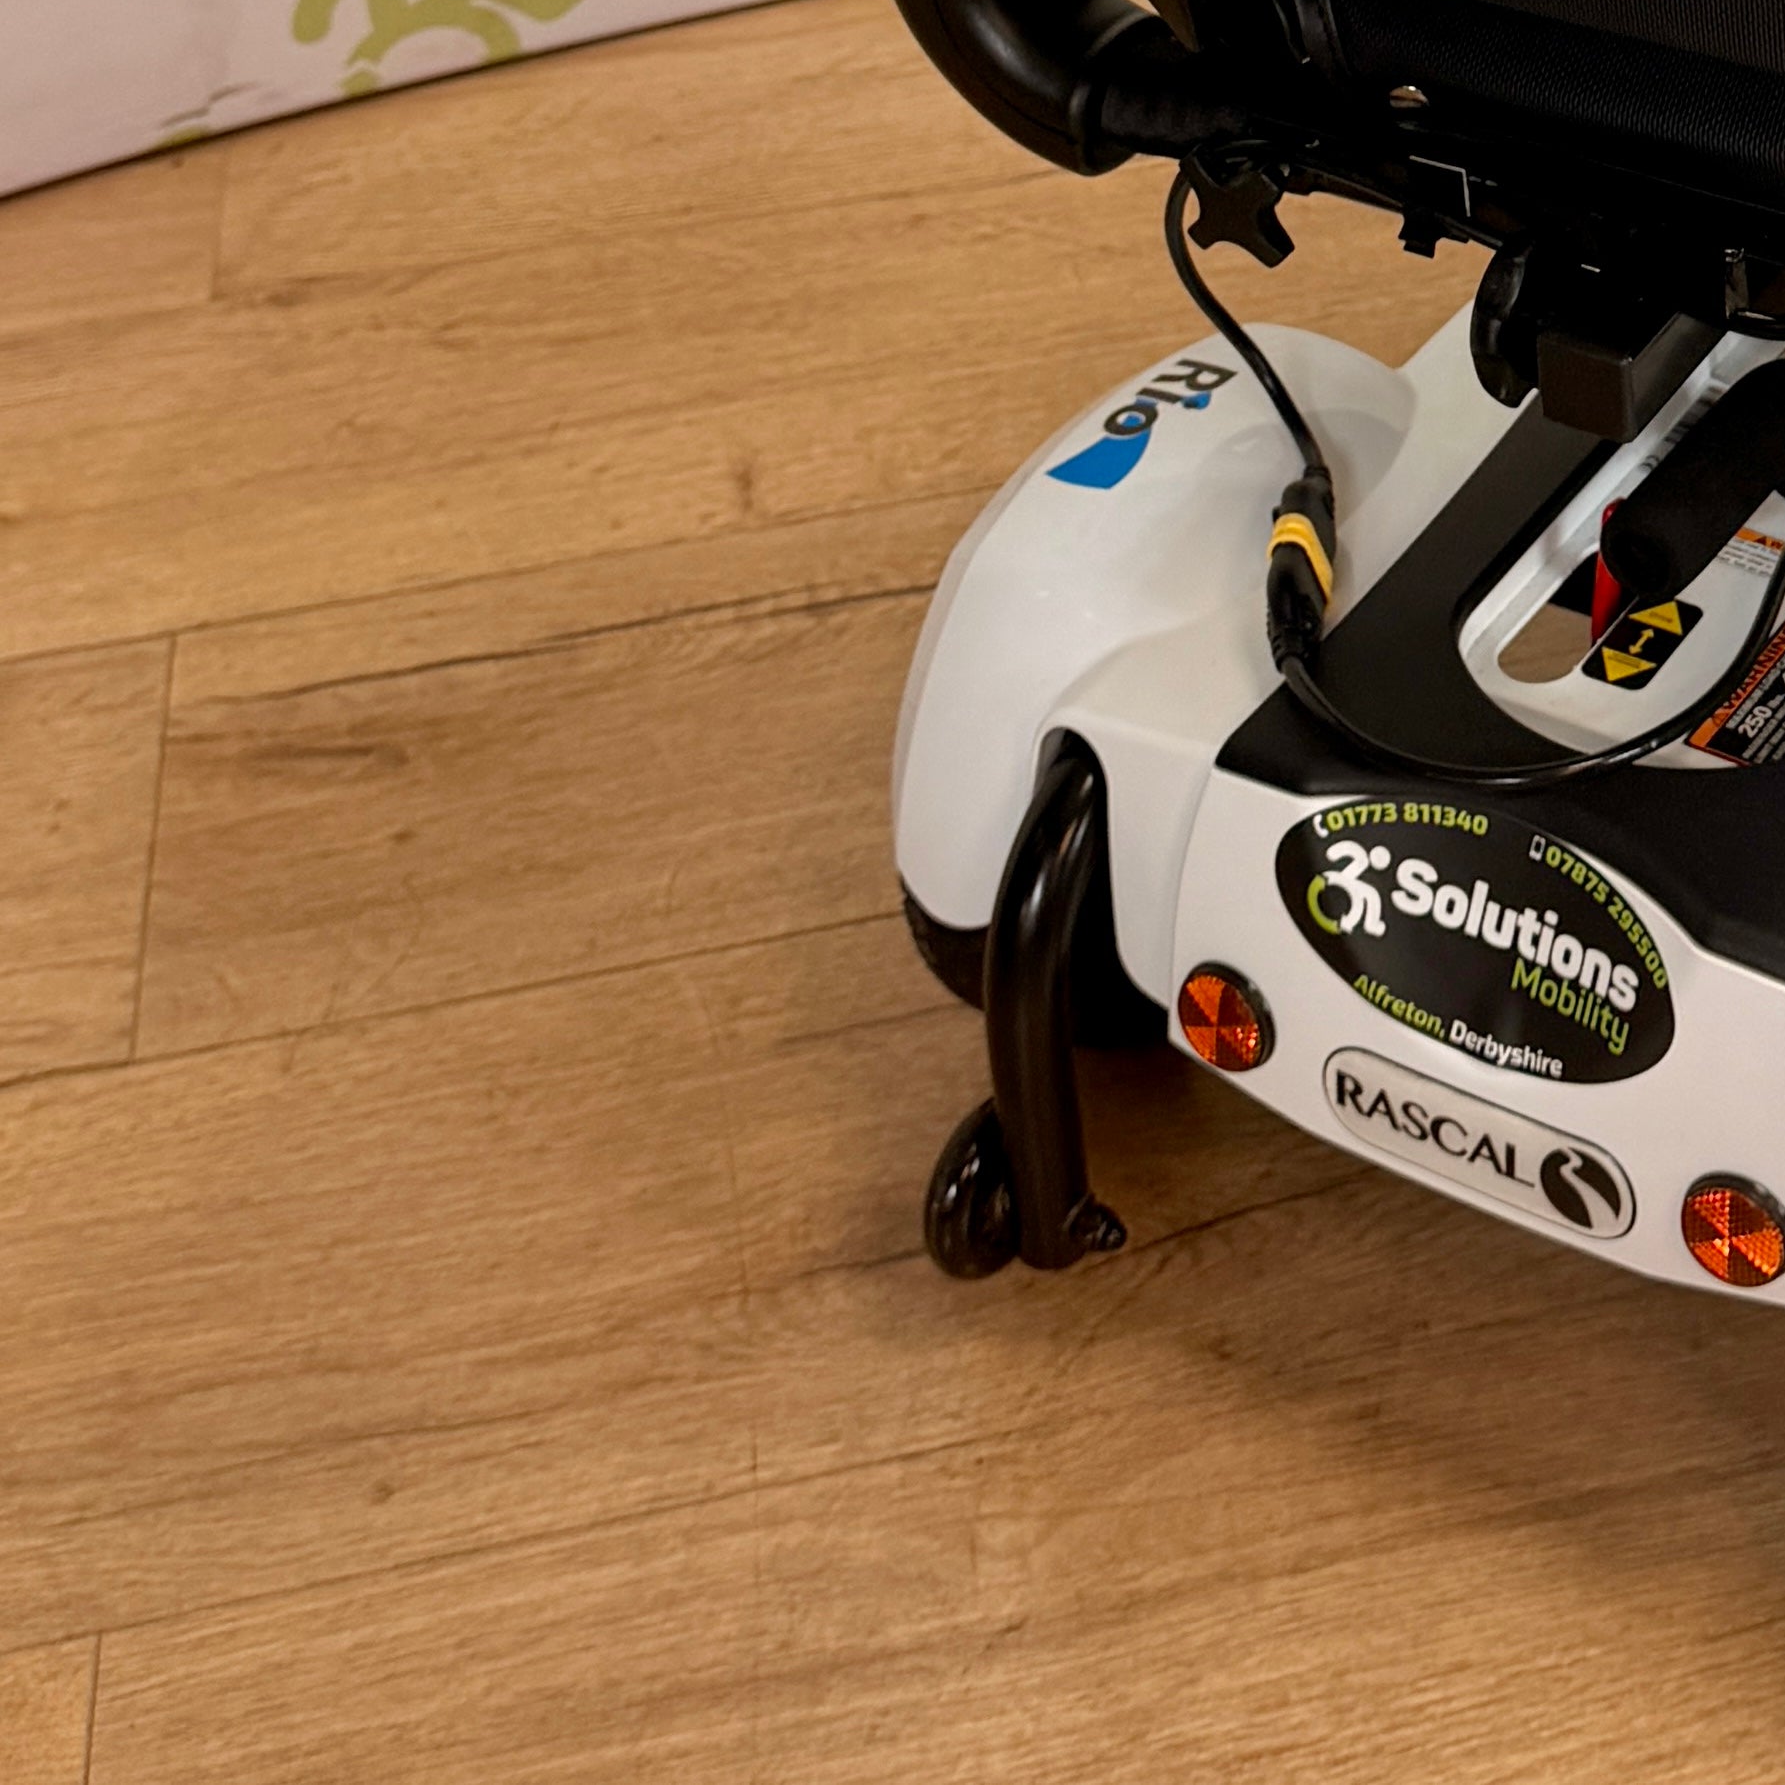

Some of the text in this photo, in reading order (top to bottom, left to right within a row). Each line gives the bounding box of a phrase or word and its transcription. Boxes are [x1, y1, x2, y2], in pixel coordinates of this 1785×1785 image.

[1103, 358, 1238, 436] Rio
[1325, 802, 1489, 836] 01773 811340
[1545, 844, 1610, 904] 07875
[1391, 856, 1640, 1013] Solutions
[1510, 956, 1631, 1057] Mobility
[1449, 1018, 1564, 1079] Derbyshire
[1336, 1067, 1535, 1189] RASCAL
